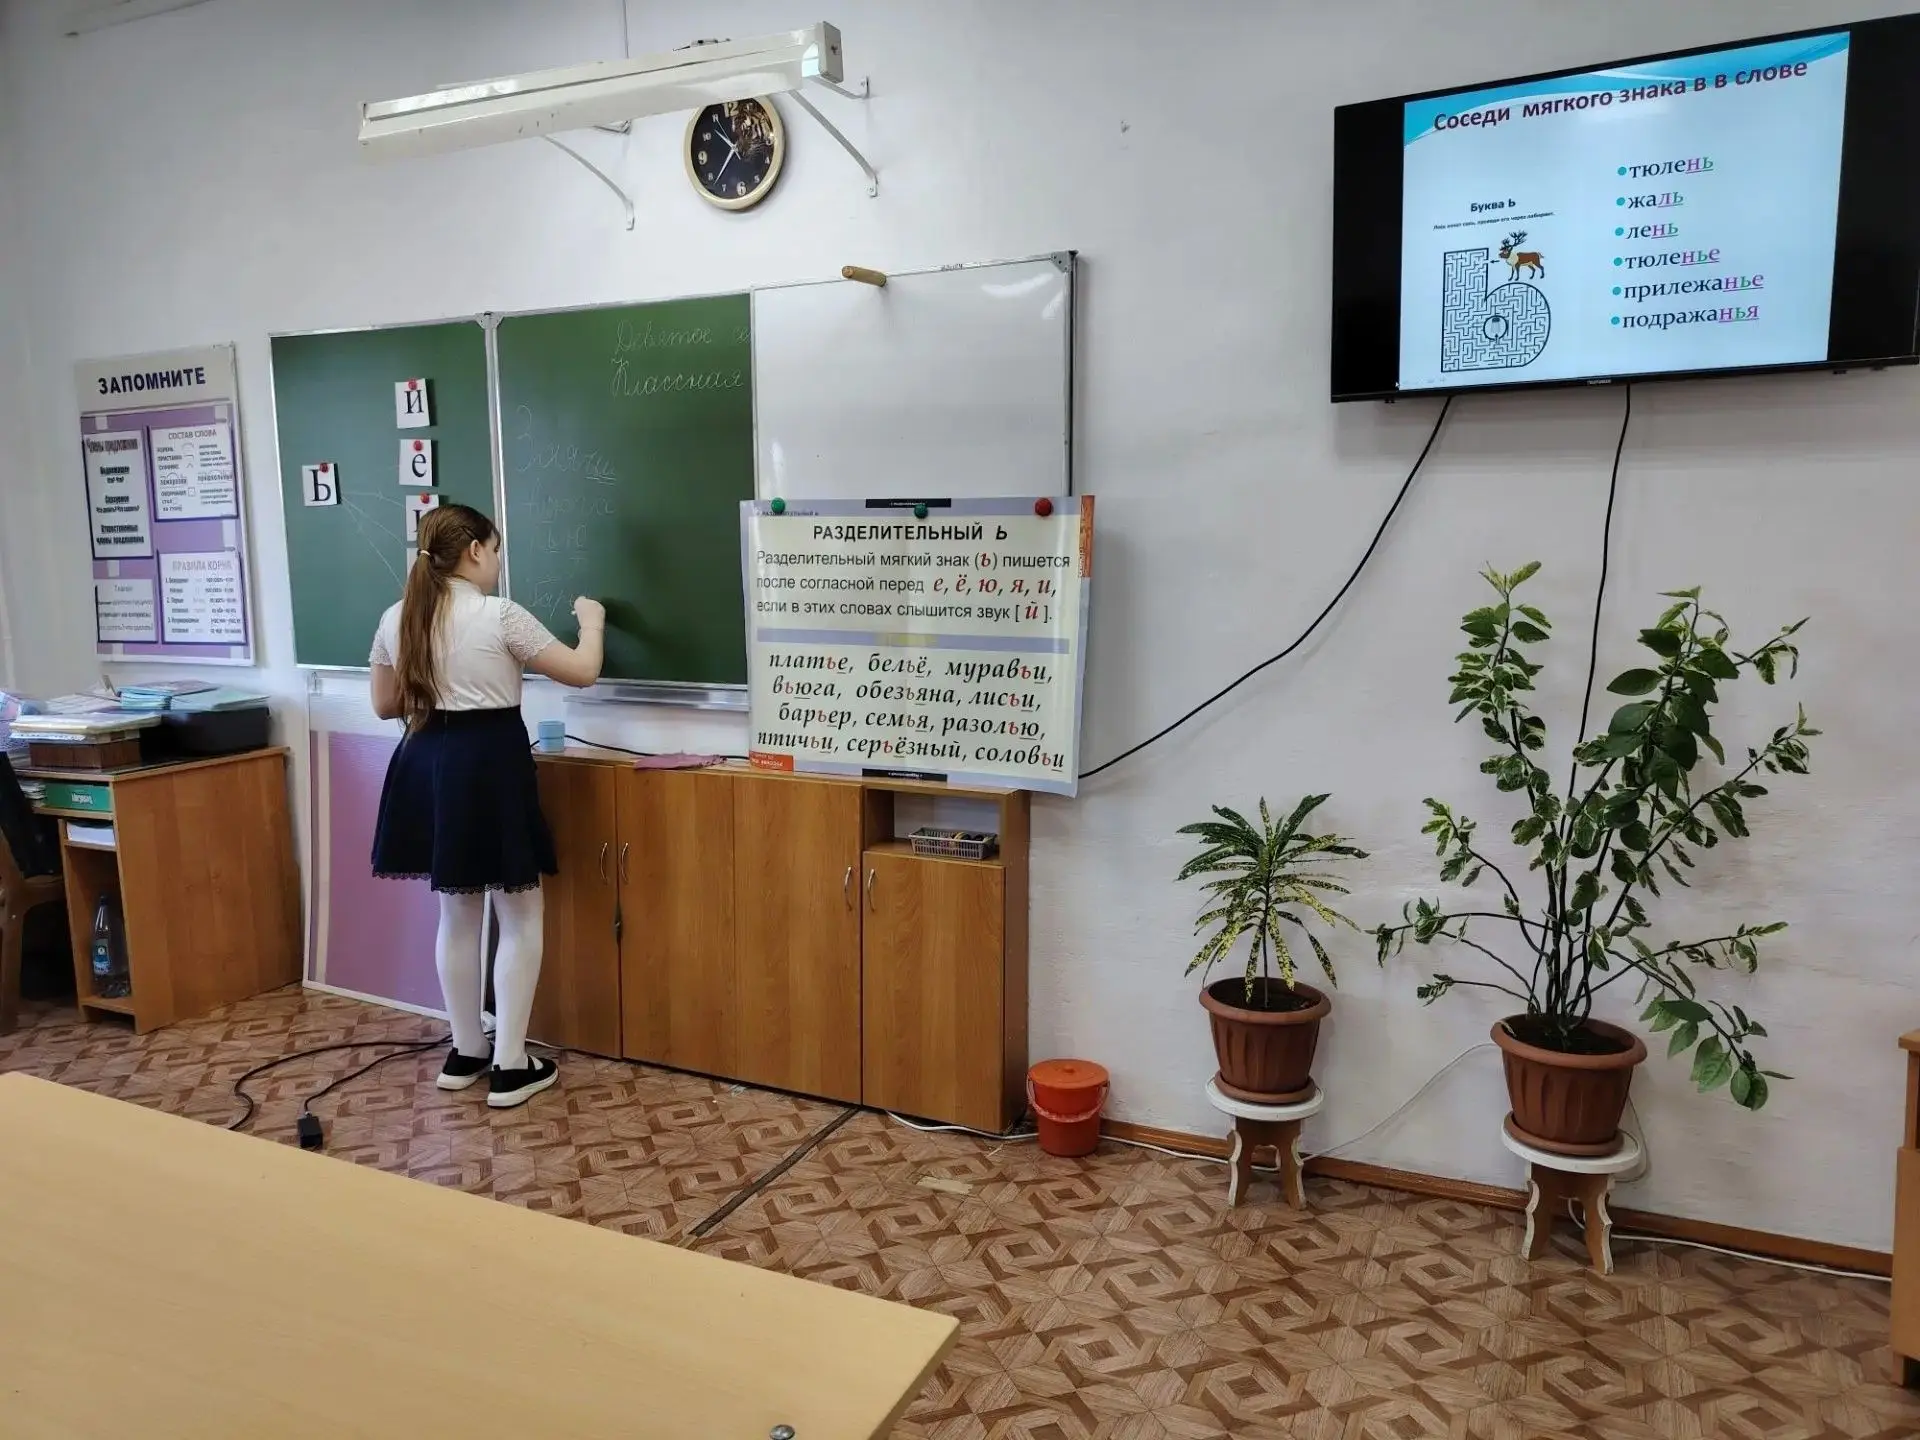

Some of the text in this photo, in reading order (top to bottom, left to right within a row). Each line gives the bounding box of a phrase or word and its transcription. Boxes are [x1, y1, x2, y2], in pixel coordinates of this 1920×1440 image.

[1434, 61, 1808, 131] Соседи мягкого знака в в слове
[723, 101, 740, 117] 12
[698, 150, 708, 165] 9
[1629, 156, 1714, 178] тюлень
[736, 181, 747, 196] 6
[1470, 200, 1505, 213] Буква
[1628, 191, 1684, 209] жаль
[1626, 222, 1679, 240] лень
[1625, 248, 1721, 269] тюленье
[1624, 274, 1764, 303] прилежанье
[1622, 304, 1760, 330] подражанья
[98, 366, 206, 395] ЗАПОМНИТЕ
[813, 522, 983, 543] РАЗДЕЛИТЕЛЬНЫЙ
[757, 550, 876, 566] Разделительный
[880, 552, 931, 567] мягкий
[936, 554, 970, 567] знак
[1003, 555, 1070, 567] пишется
[756, 574, 1057, 597] после согласной перед е, ё, ю, я, и,
[757, 601, 787, 612] если
[791, 602, 800, 613] в
[804, 602, 835, 614] этих
[840, 603, 892, 616] словах
[897, 605, 972, 618] слышится
[976, 607, 1010, 622] звук
[769, 652, 1053, 684] платье, бельё, муравьи,
[772, 674, 1041, 713] вьюга, обезьяна, лисьи,
[778, 702, 1046, 741] барьер, семья, разолью,
[757, 731, 1065, 773] птичьи, серьёзный, соловьи
